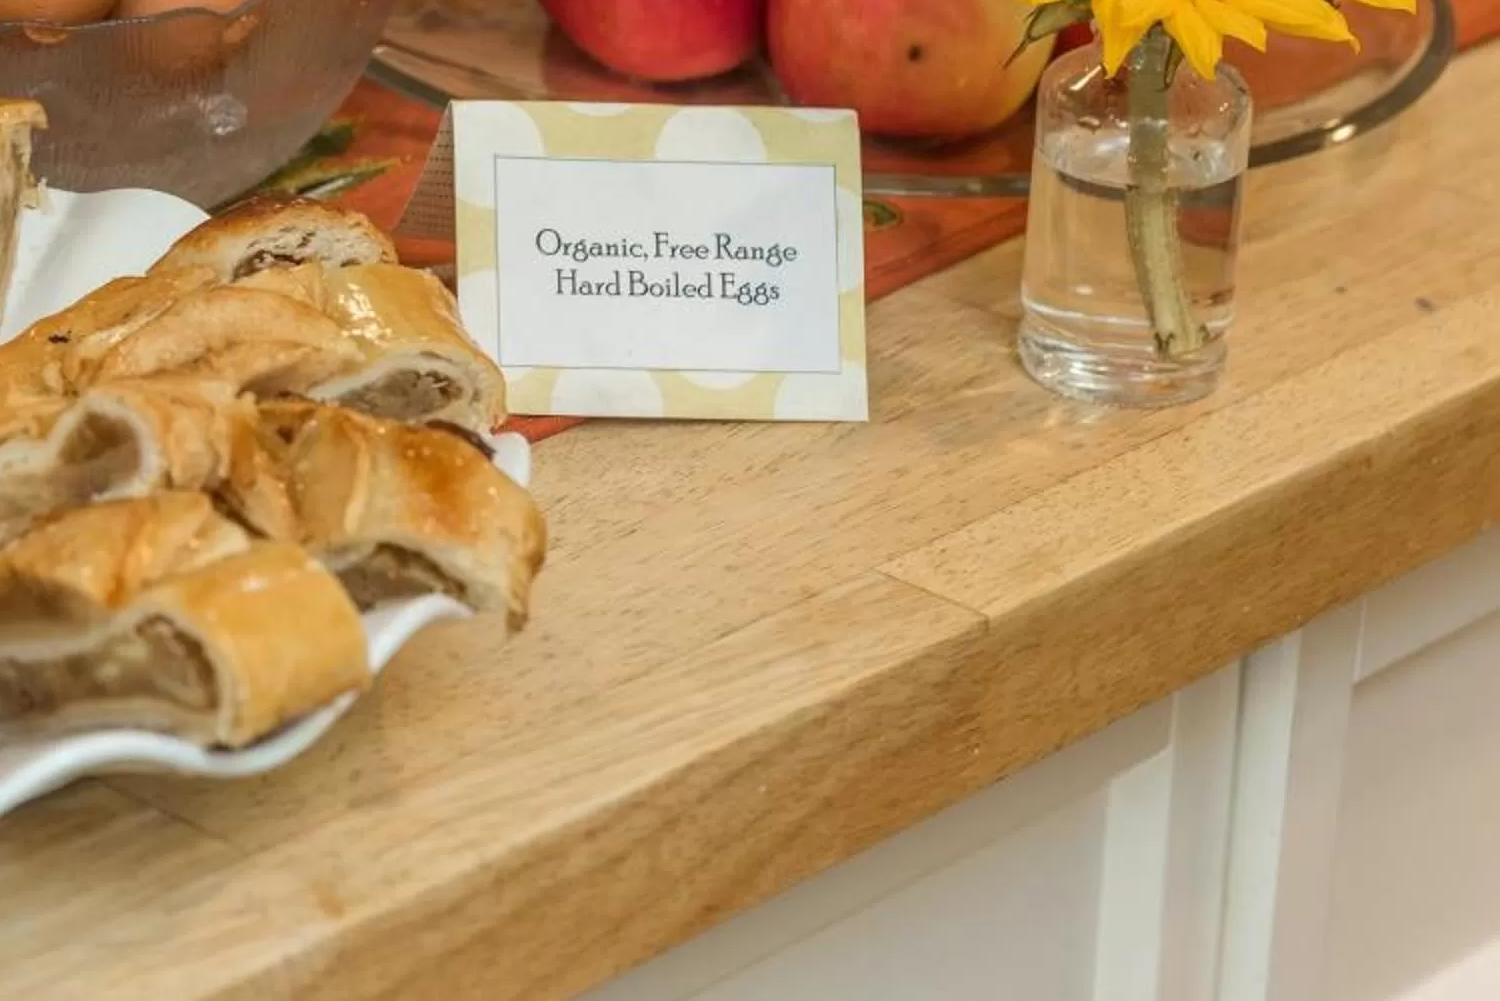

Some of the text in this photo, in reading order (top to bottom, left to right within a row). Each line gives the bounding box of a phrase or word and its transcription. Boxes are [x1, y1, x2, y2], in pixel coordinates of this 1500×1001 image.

[535, 228, 798, 268] Organic, Free Range
[555, 268, 781, 306] Hard Boiled Eggs
